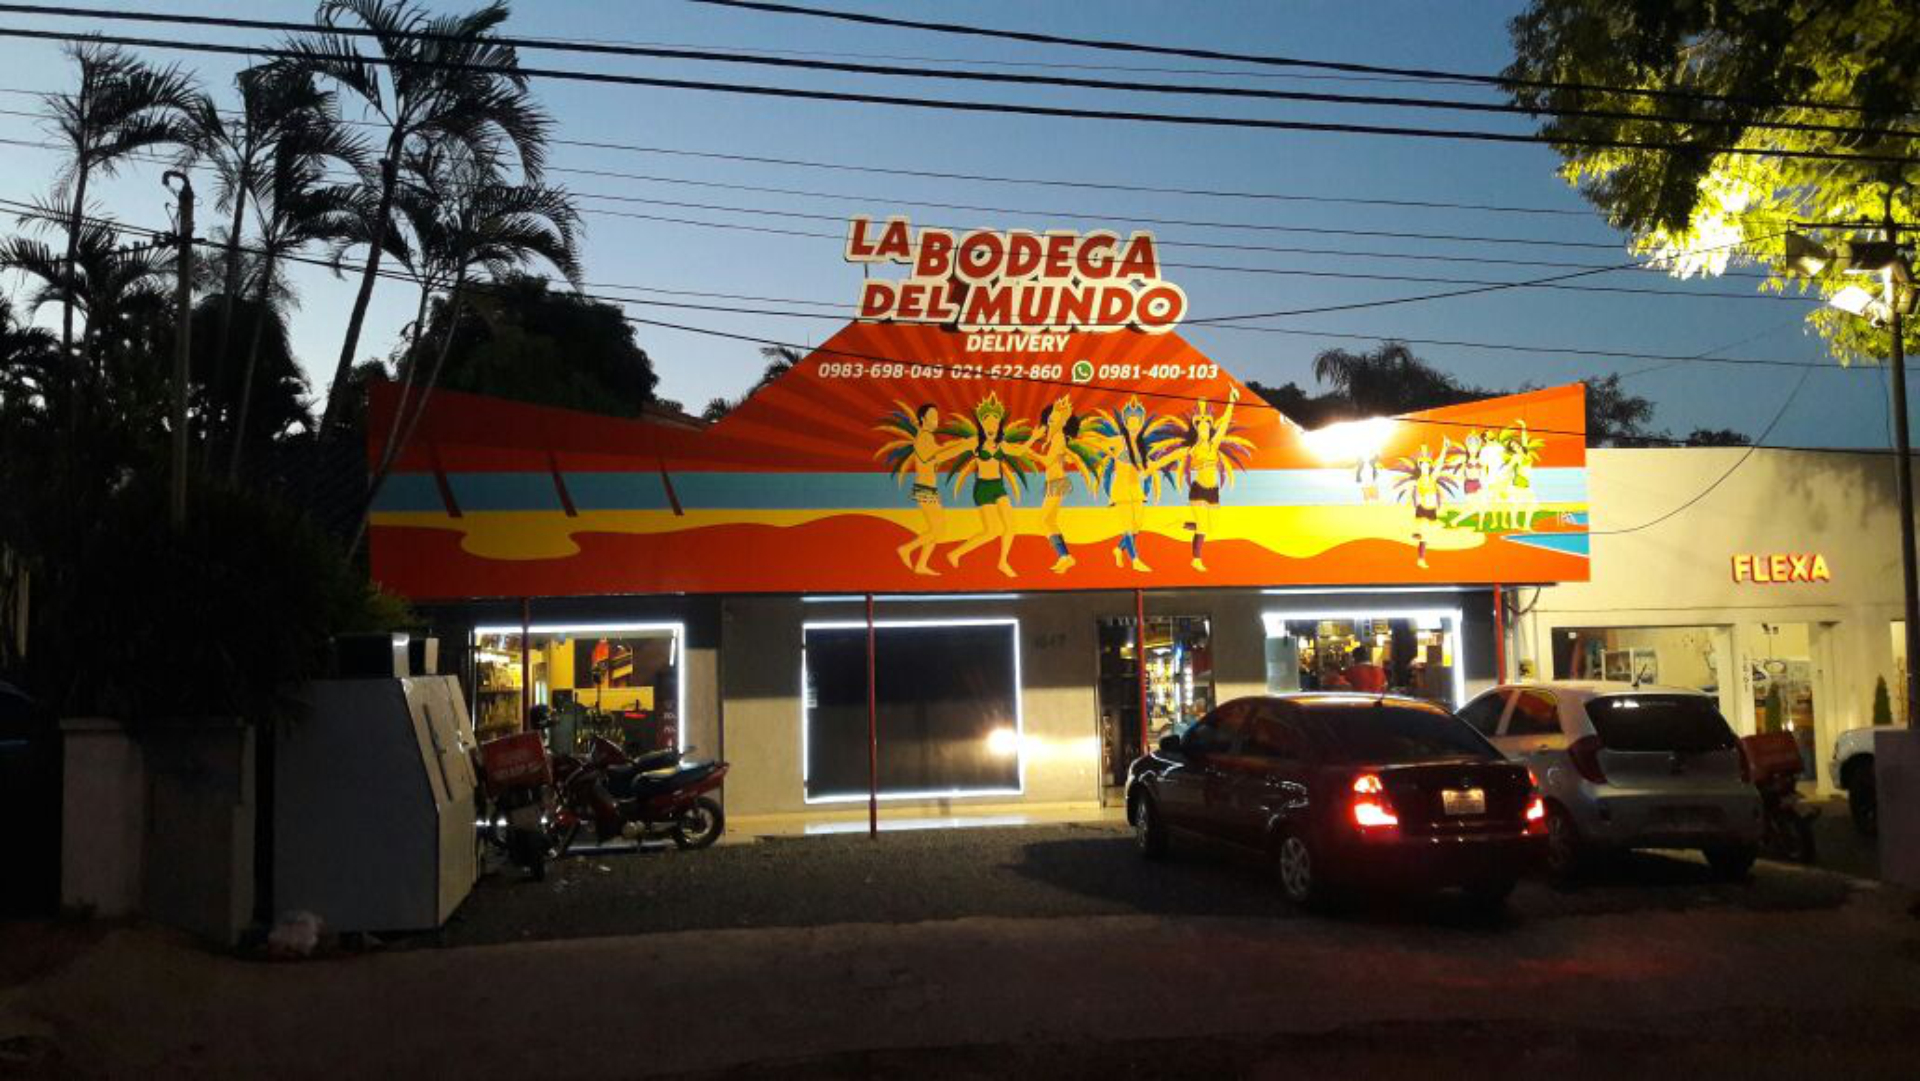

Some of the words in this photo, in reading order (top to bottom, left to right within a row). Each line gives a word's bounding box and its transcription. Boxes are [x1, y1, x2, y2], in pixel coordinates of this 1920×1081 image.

[849, 217, 911, 257] LA
[916, 230, 1157, 279] BODEGA
[860, 283, 954, 319] DEL
[963, 286, 1184, 328] MUNDO
[966, 334, 1070, 352] DELIVERY
[818, 362, 944, 379] 0983-698-049
[951, 364, 1063, 379] 021-622-860
[1098, 363, 1219, 380] 0981-400-103
[1731, 553, 1830, 584] FLEXA
